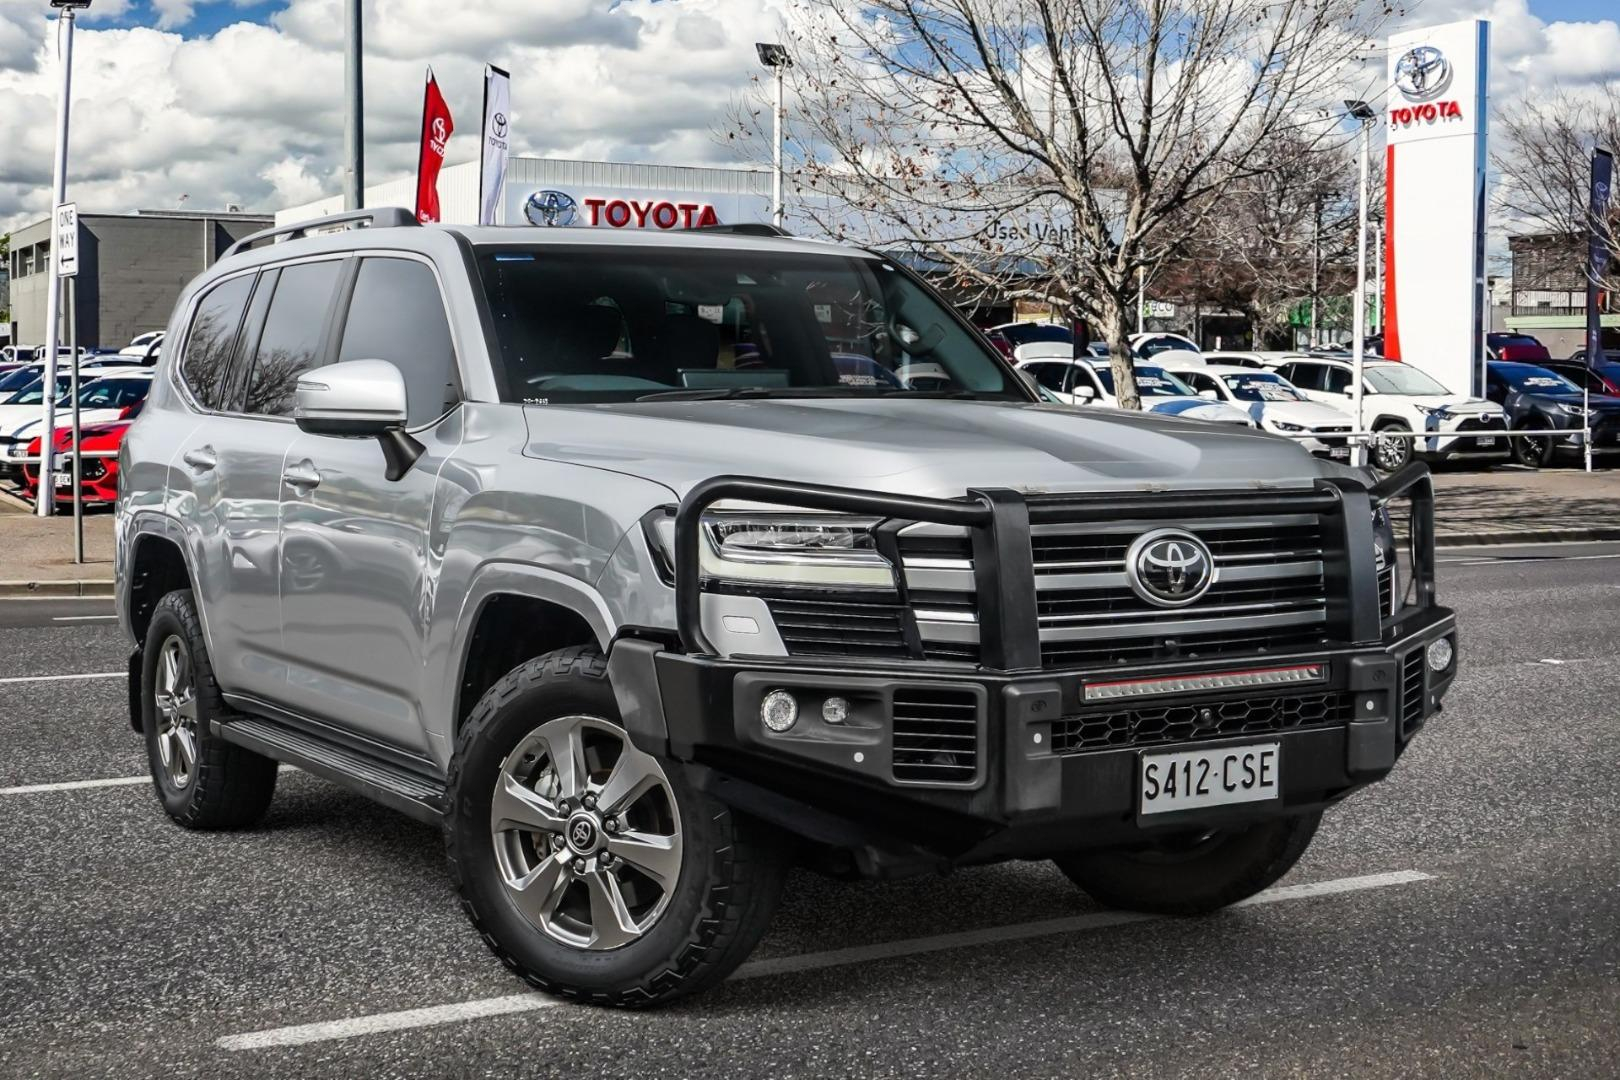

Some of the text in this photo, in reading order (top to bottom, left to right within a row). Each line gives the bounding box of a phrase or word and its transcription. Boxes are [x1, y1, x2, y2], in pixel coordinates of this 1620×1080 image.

[1389, 101, 1462, 125] TOYOTA
[59, 209, 74, 228] ONE
[584, 199, 719, 230] TOYOTA
[59, 231, 76, 249] WAY
[985, 220, 1031, 241] Used
